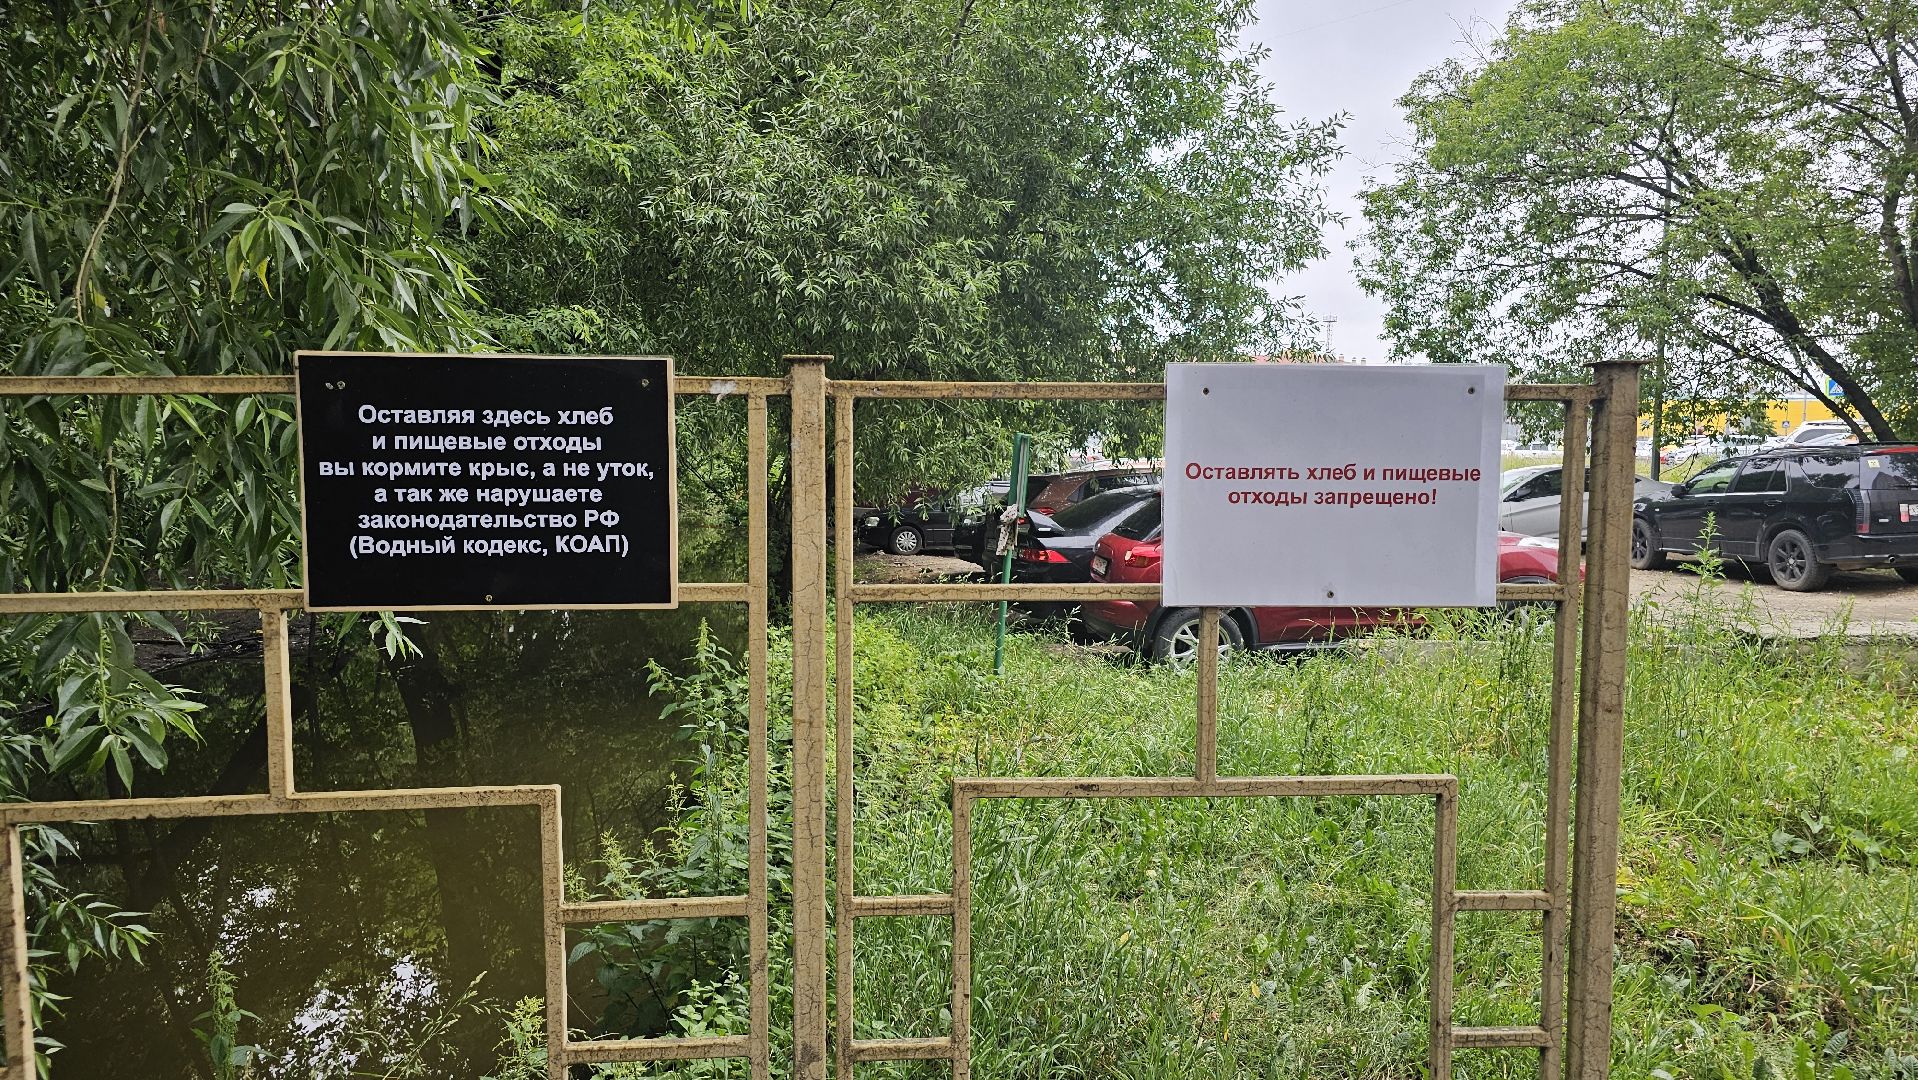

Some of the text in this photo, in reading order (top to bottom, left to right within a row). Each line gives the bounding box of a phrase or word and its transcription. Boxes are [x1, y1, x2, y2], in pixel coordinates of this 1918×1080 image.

[358, 404, 614, 428] Оставляя здесь хлеб
[372, 435, 602, 453] и пищевые отходы
[319, 461, 654, 481] вы кормите крыс, а не уток,
[1185, 462, 1481, 482] Оставлять хлеб и пищевые
[373, 488, 603, 506] а так же нарушаете
[1227, 488, 1437, 508] отходы запрещено!
[357, 509, 620, 531] законодательство РФ
[349, 534, 629, 560] (Водный кодекс, КОАП)
